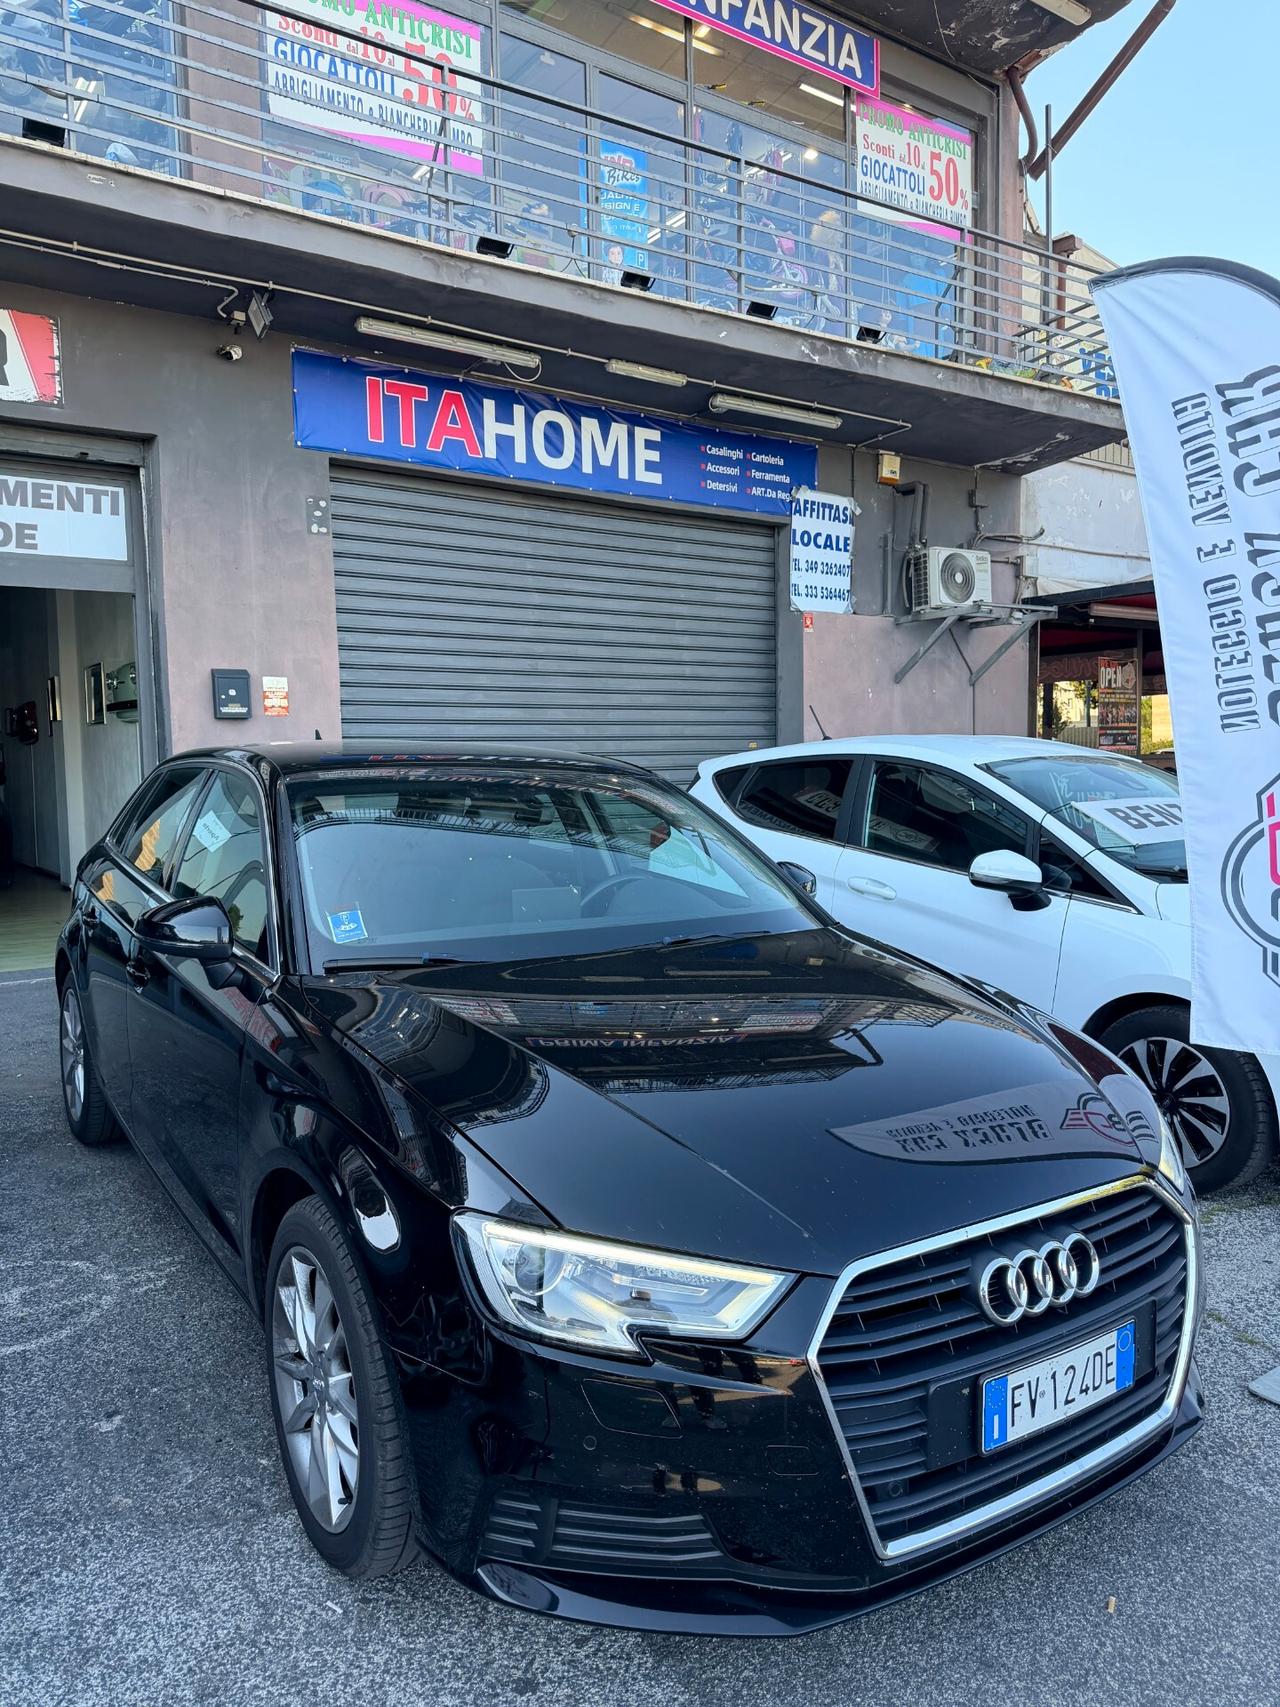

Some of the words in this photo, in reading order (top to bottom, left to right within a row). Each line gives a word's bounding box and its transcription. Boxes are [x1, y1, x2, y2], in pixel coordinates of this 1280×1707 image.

[278, 15, 339, 48] Sconti
[346, 42, 359, 55] dal
[360, 26, 387, 64] 10
[387, 54, 395, 67] al
[364, 3, 473, 59] ANTICRISI
[274, 37, 396, 97] GIOCATTOLI
[274, 71, 364, 124] ABBIGLIAMENTO
[860, 103, 904, 136] PROMO
[909, 122, 967, 160] ANTICRISI
[863, 134, 895, 159] Sconti
[906, 142, 921, 168] 10
[861, 155, 926, 197] GIOCATTOLI
[365, 375, 664, 486] ITAHOME
[706, 444, 744, 460] Casalinghi
[751, 452, 784, 466] Cartoleria
[706, 462, 740, 476] Accessori
[751, 470, 790, 484] Ferramenta
[707, 479, 738, 493] Detersivi
[751, 487, 776, 499] ART.Da
[792, 528, 850, 553] LOCALE
[805, 560, 819, 574] 349
[820, 561, 852, 578] 3262407
[805, 585, 818, 599] 333
[820, 586, 851, 602] 5364467
[1100, 665, 1122, 689] OPEN
